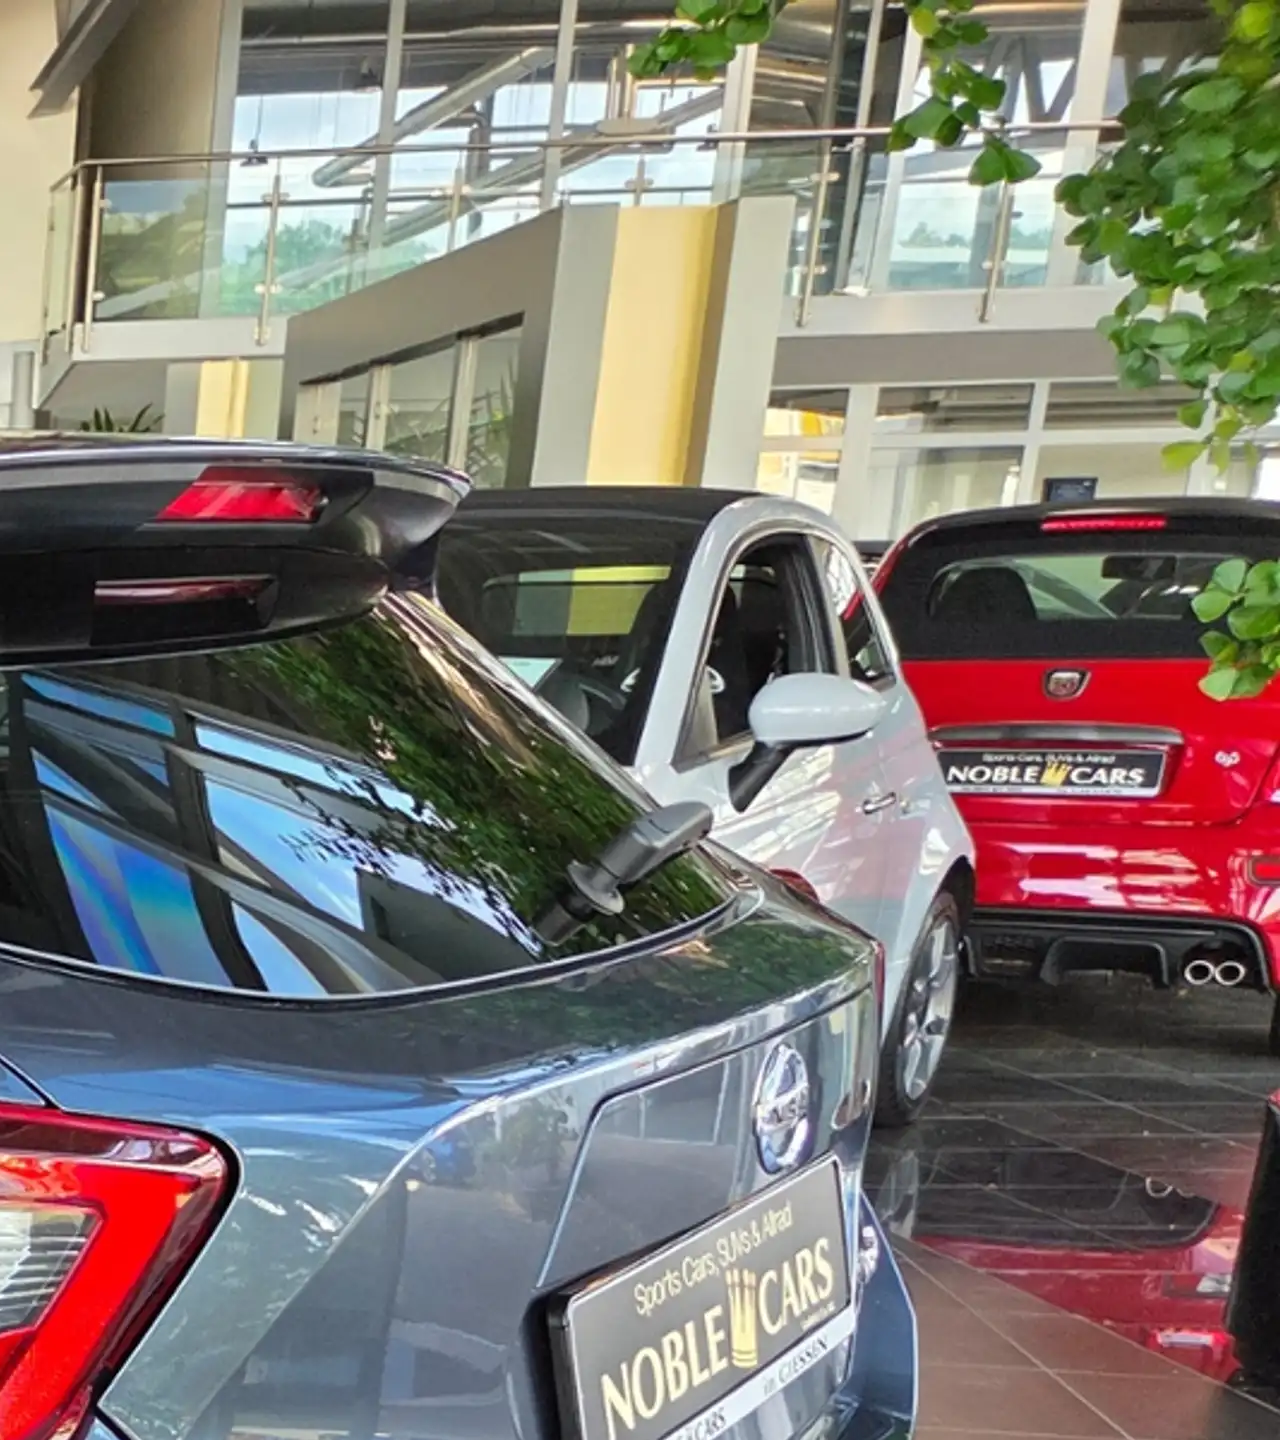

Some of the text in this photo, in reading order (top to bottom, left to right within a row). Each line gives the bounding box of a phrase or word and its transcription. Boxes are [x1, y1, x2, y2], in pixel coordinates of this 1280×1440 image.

[946, 766, 1145, 784] NOBLE CARS
[634, 1270, 682, 1317] Sports
[682, 1252, 720, 1288] Cars,
[715, 1228, 752, 1268] SUVs
[761, 1198, 794, 1239] Allrad
[757, 1237, 835, 1336] CARS
